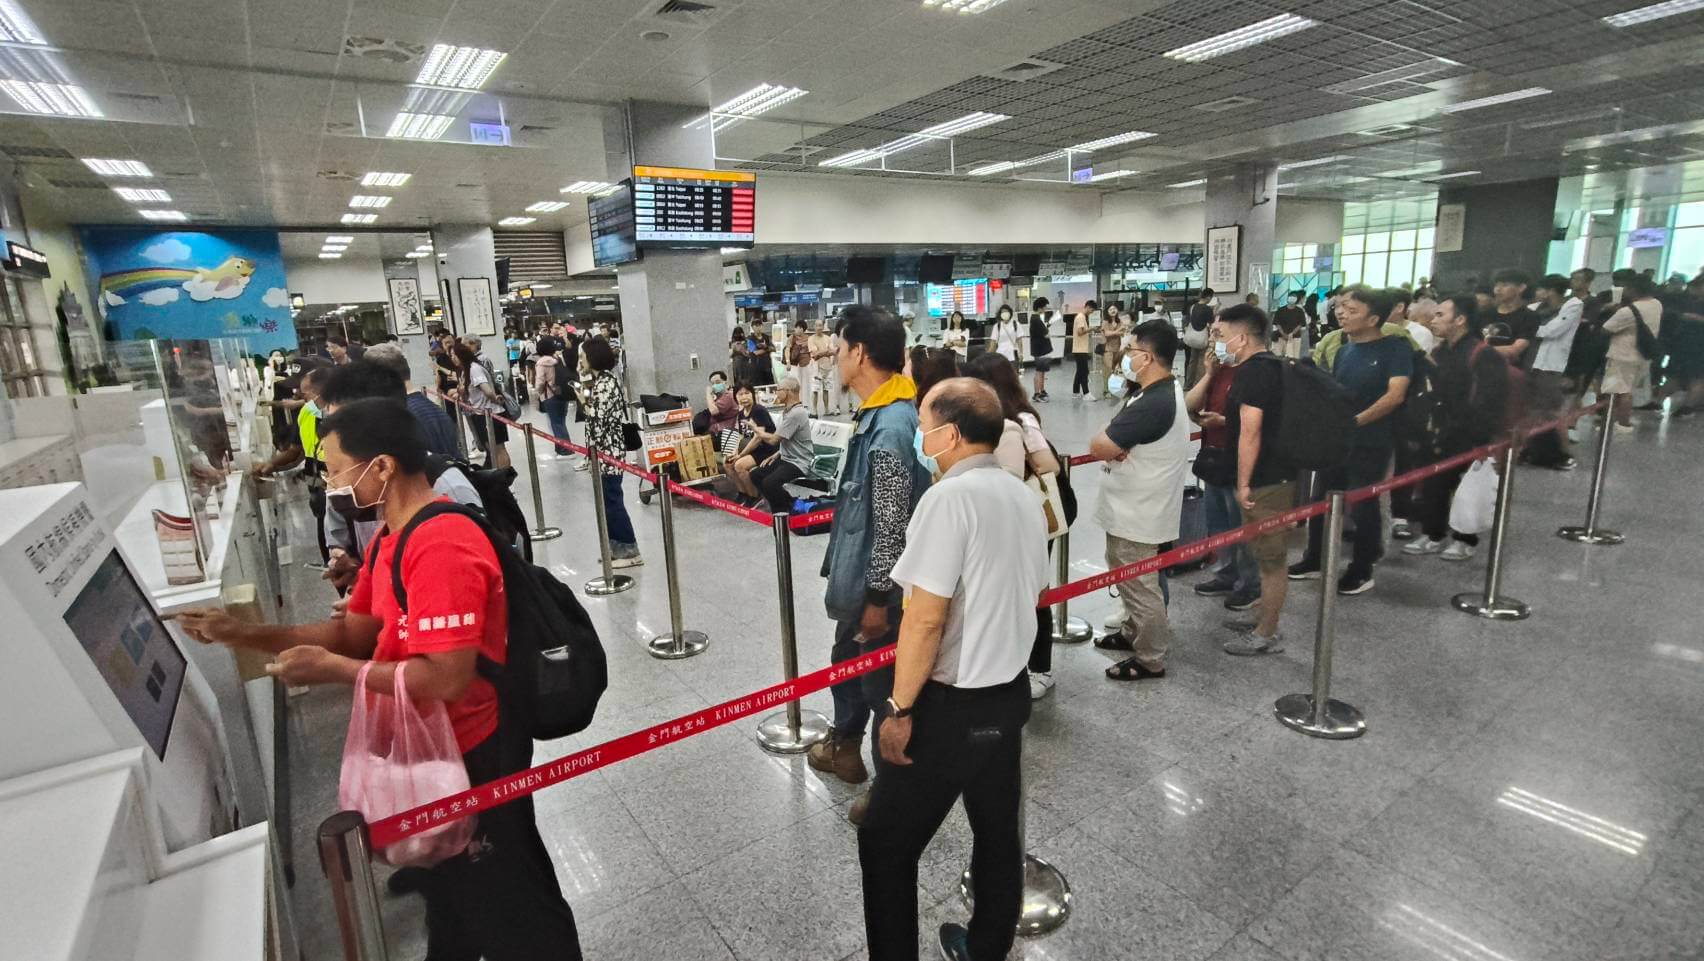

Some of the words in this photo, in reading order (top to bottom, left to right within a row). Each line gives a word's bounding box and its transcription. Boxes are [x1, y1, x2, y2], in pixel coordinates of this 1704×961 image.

[648, 717, 706, 744] 金門航空站
[715, 701, 752, 720] KINMEN
[756, 684, 796, 706] AIRPORT
[399, 795, 479, 832] 金門航空站
[493, 771, 543, 799] KINMEN
[549, 750, 602, 779] AIRPORT
